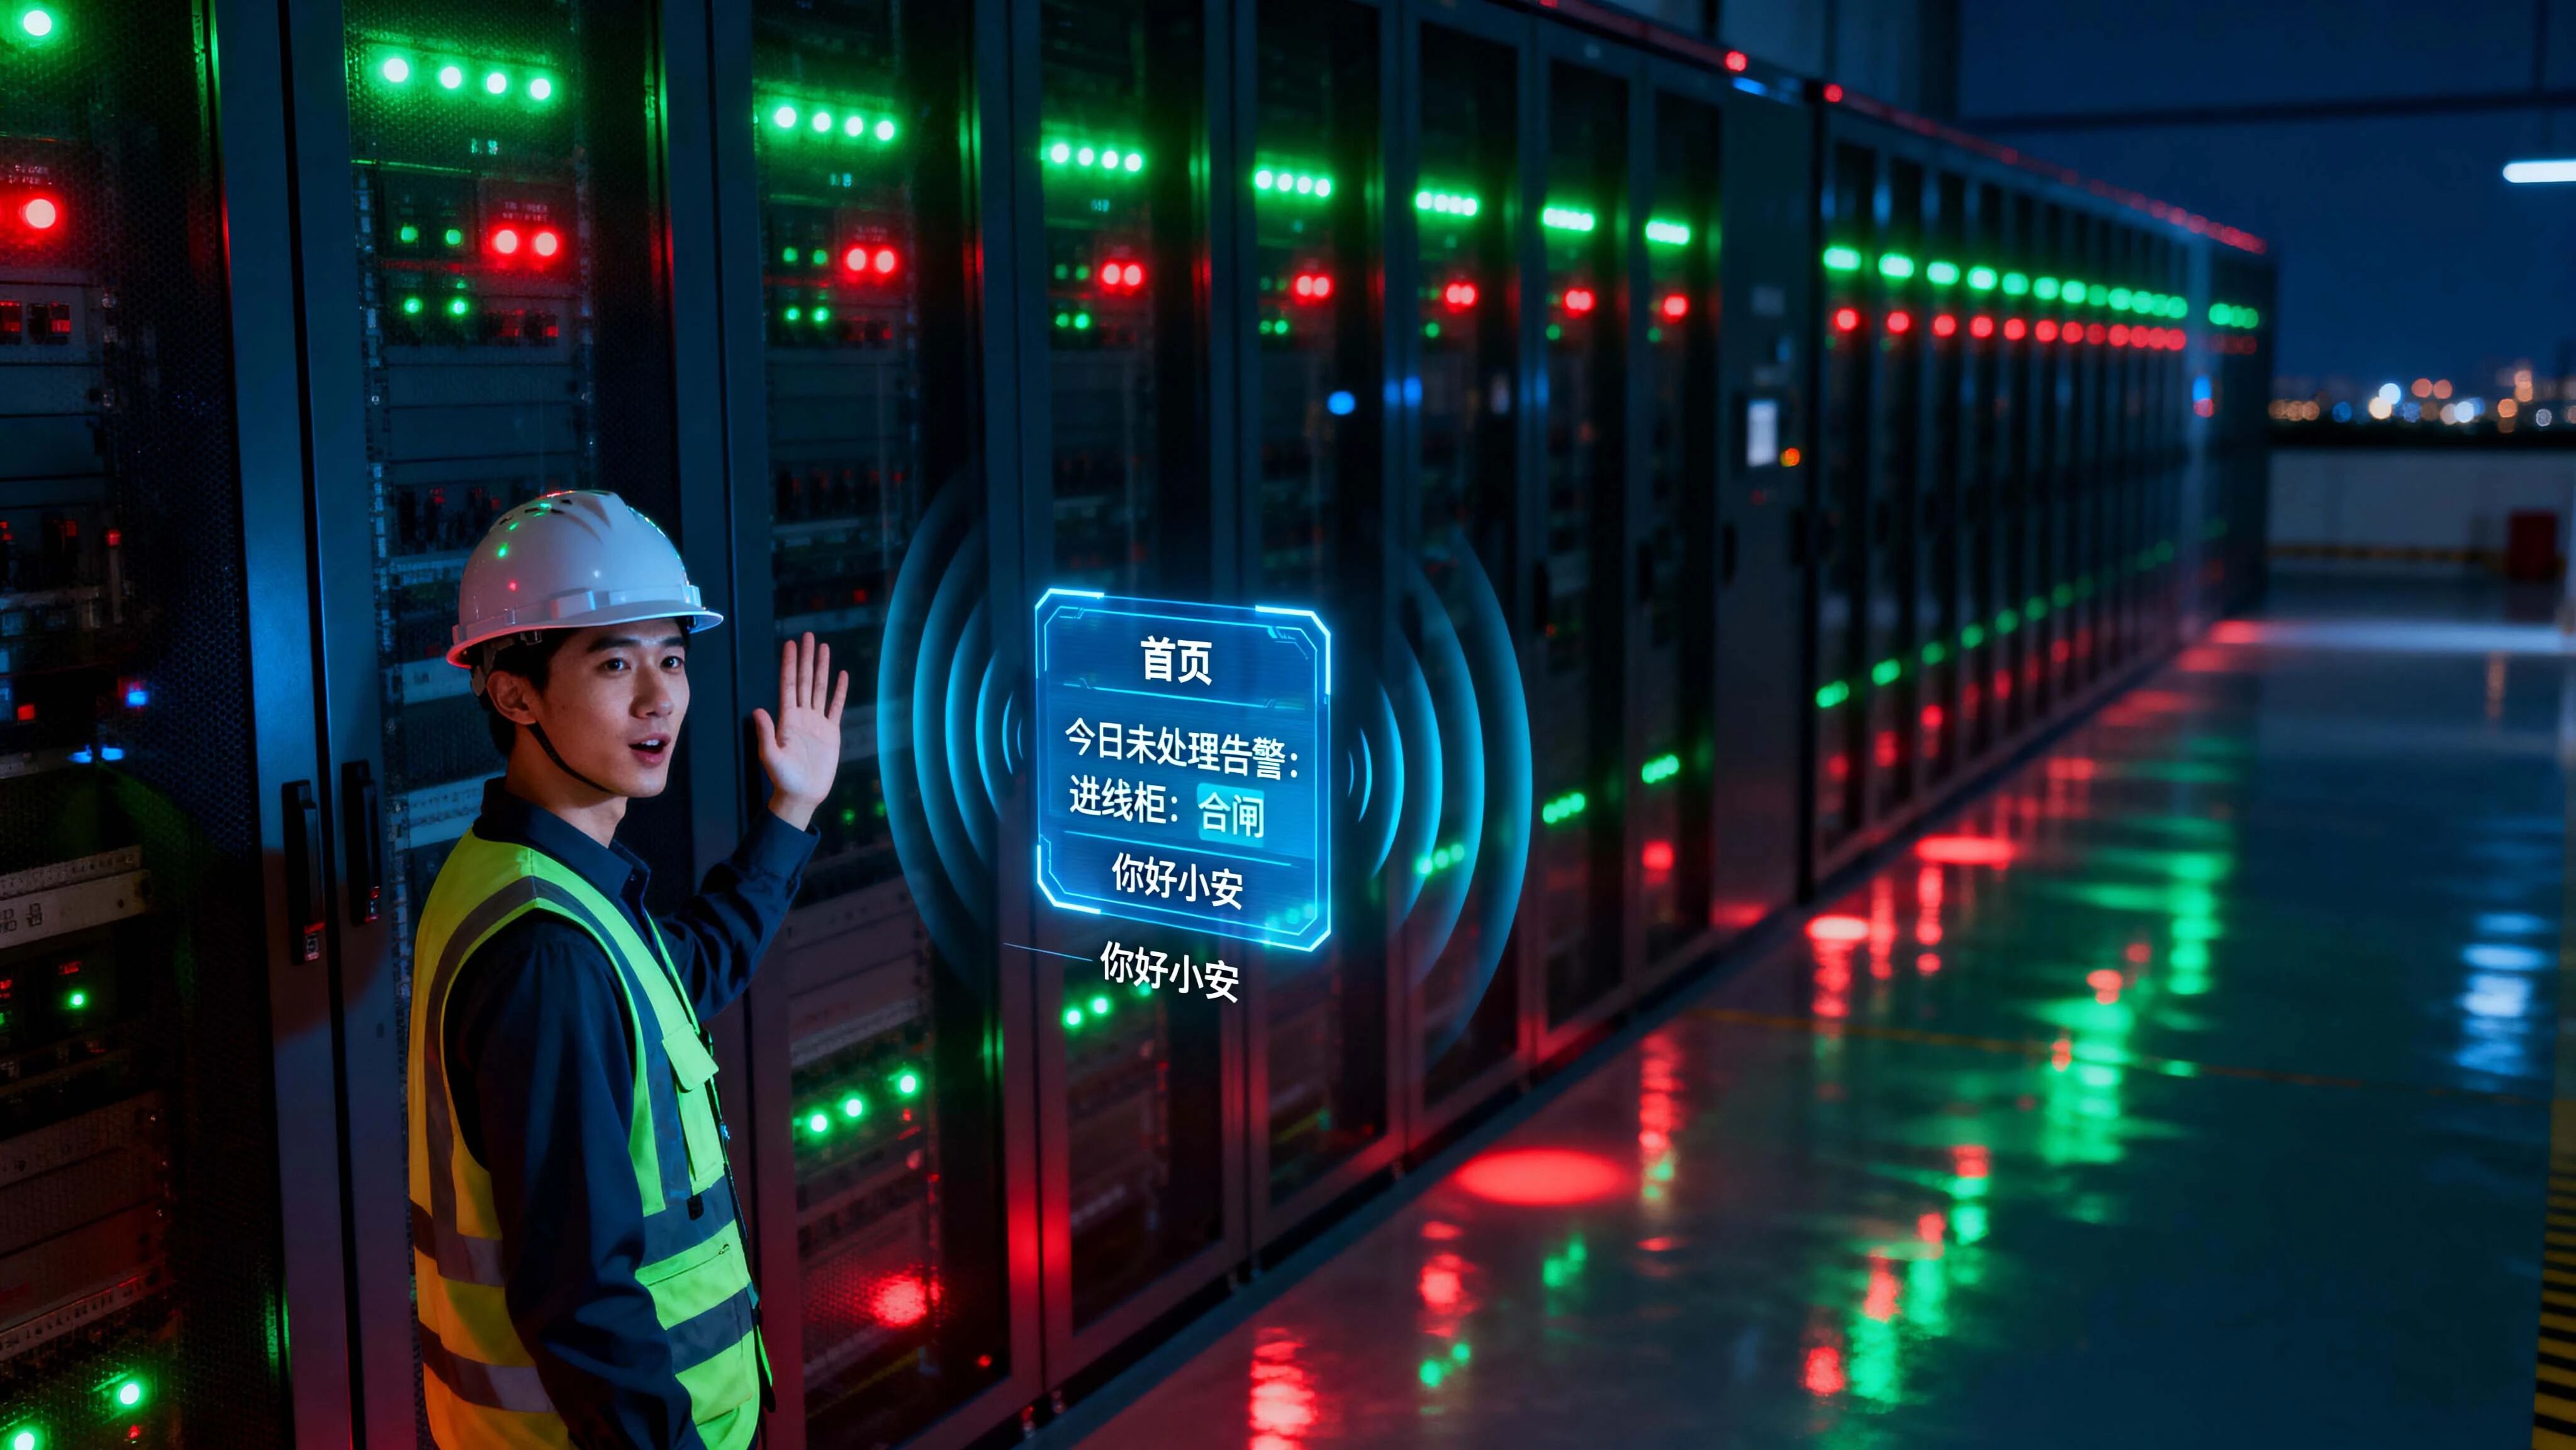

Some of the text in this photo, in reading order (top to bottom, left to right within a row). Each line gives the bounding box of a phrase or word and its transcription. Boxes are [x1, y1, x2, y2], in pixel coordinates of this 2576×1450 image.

[1141, 636, 1212, 685] 首页
[1198, 792, 1265, 840] 合闸
[1111, 852, 1243, 911] 你好小安
[1099, 940, 1240, 1004] 你好小安
